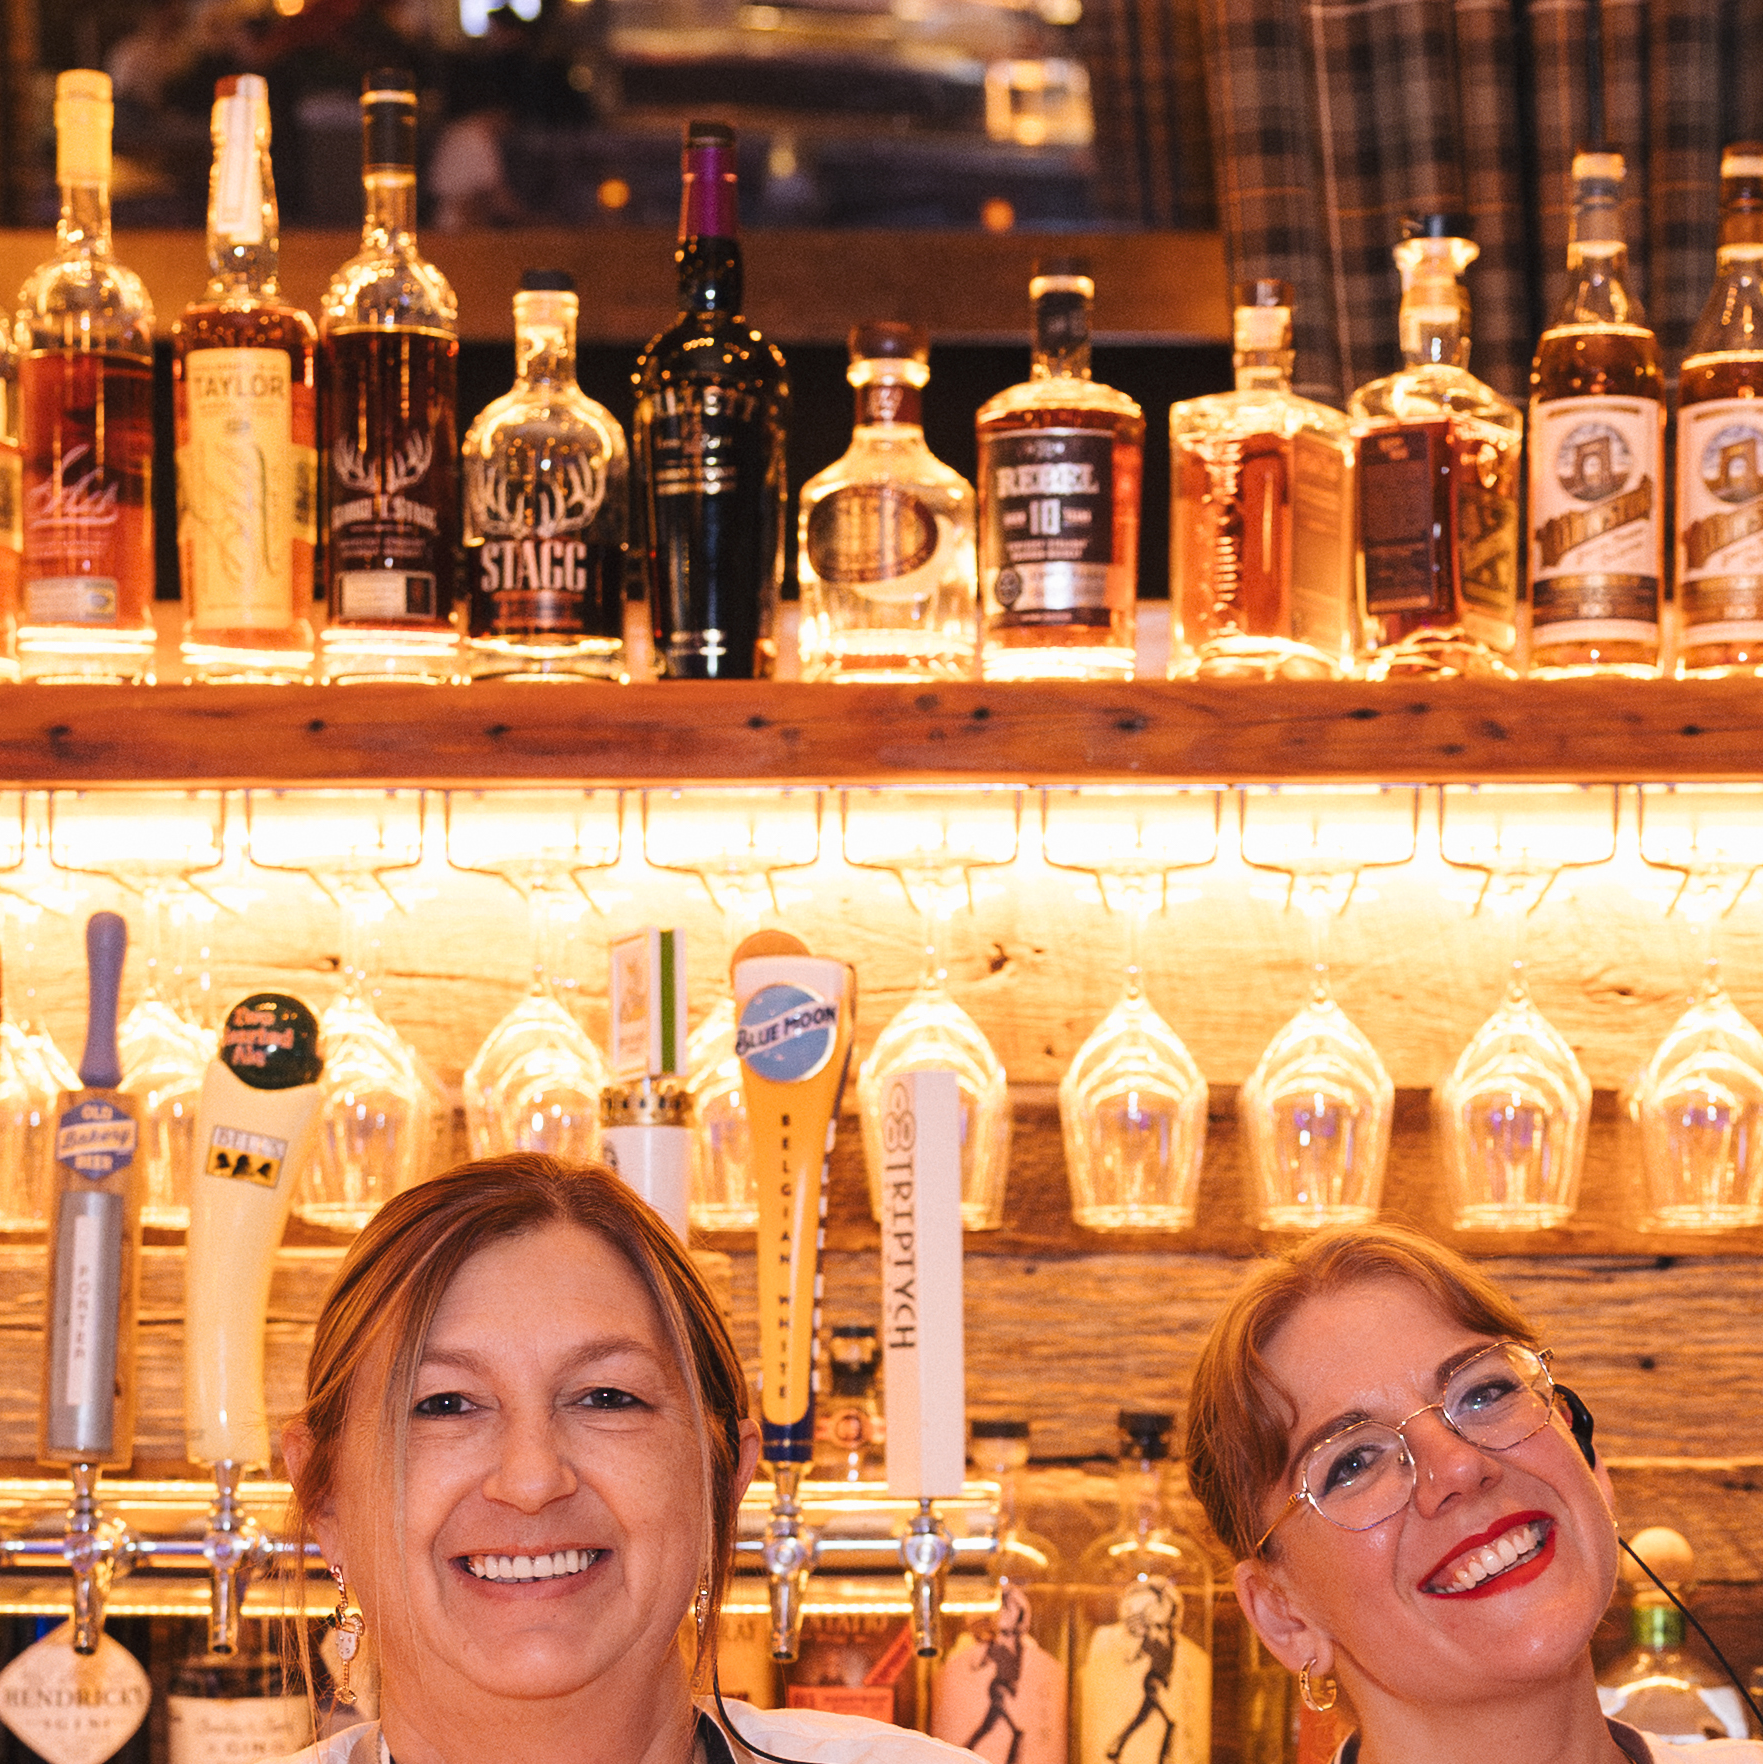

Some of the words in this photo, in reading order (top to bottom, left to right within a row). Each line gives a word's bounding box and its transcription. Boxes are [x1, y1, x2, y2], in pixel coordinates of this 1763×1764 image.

[193, 374, 285, 399] TAYLOR
[736, 1023, 779, 1056] BLUE
[784, 1005, 836, 1037] MOON
[781, 1113, 792, 1265] BELGIAN
[885, 1160, 917, 1351] TRIPTYCH
[779, 1294, 791, 1400] WHITE
